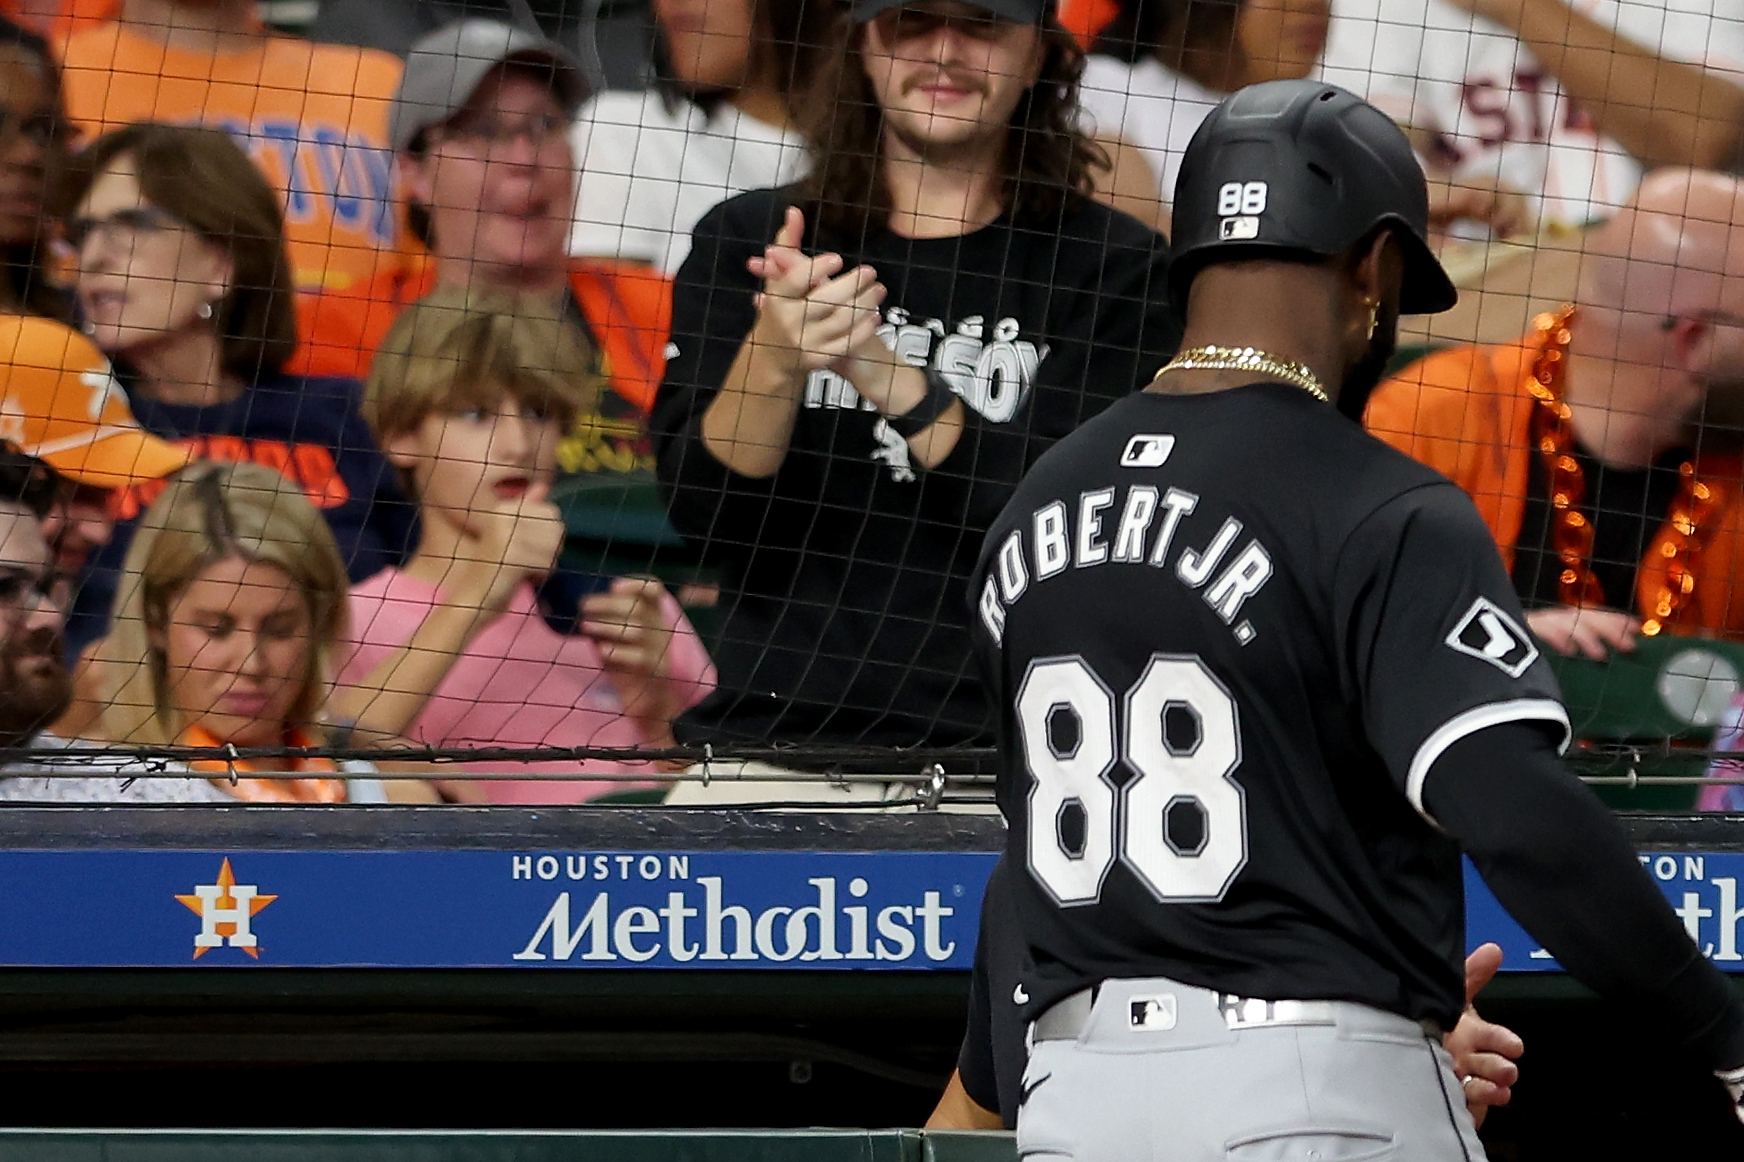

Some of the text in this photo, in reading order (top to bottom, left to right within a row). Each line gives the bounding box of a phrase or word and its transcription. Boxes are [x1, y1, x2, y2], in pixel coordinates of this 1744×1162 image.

[1217, 181, 1268, 216] 88
[979, 484, 1274, 648] ROBERT JR.
[1014, 652, 1249, 909] 88
[512, 855, 689, 880] HOUSTON
[512, 876, 956, 962] Methodist
